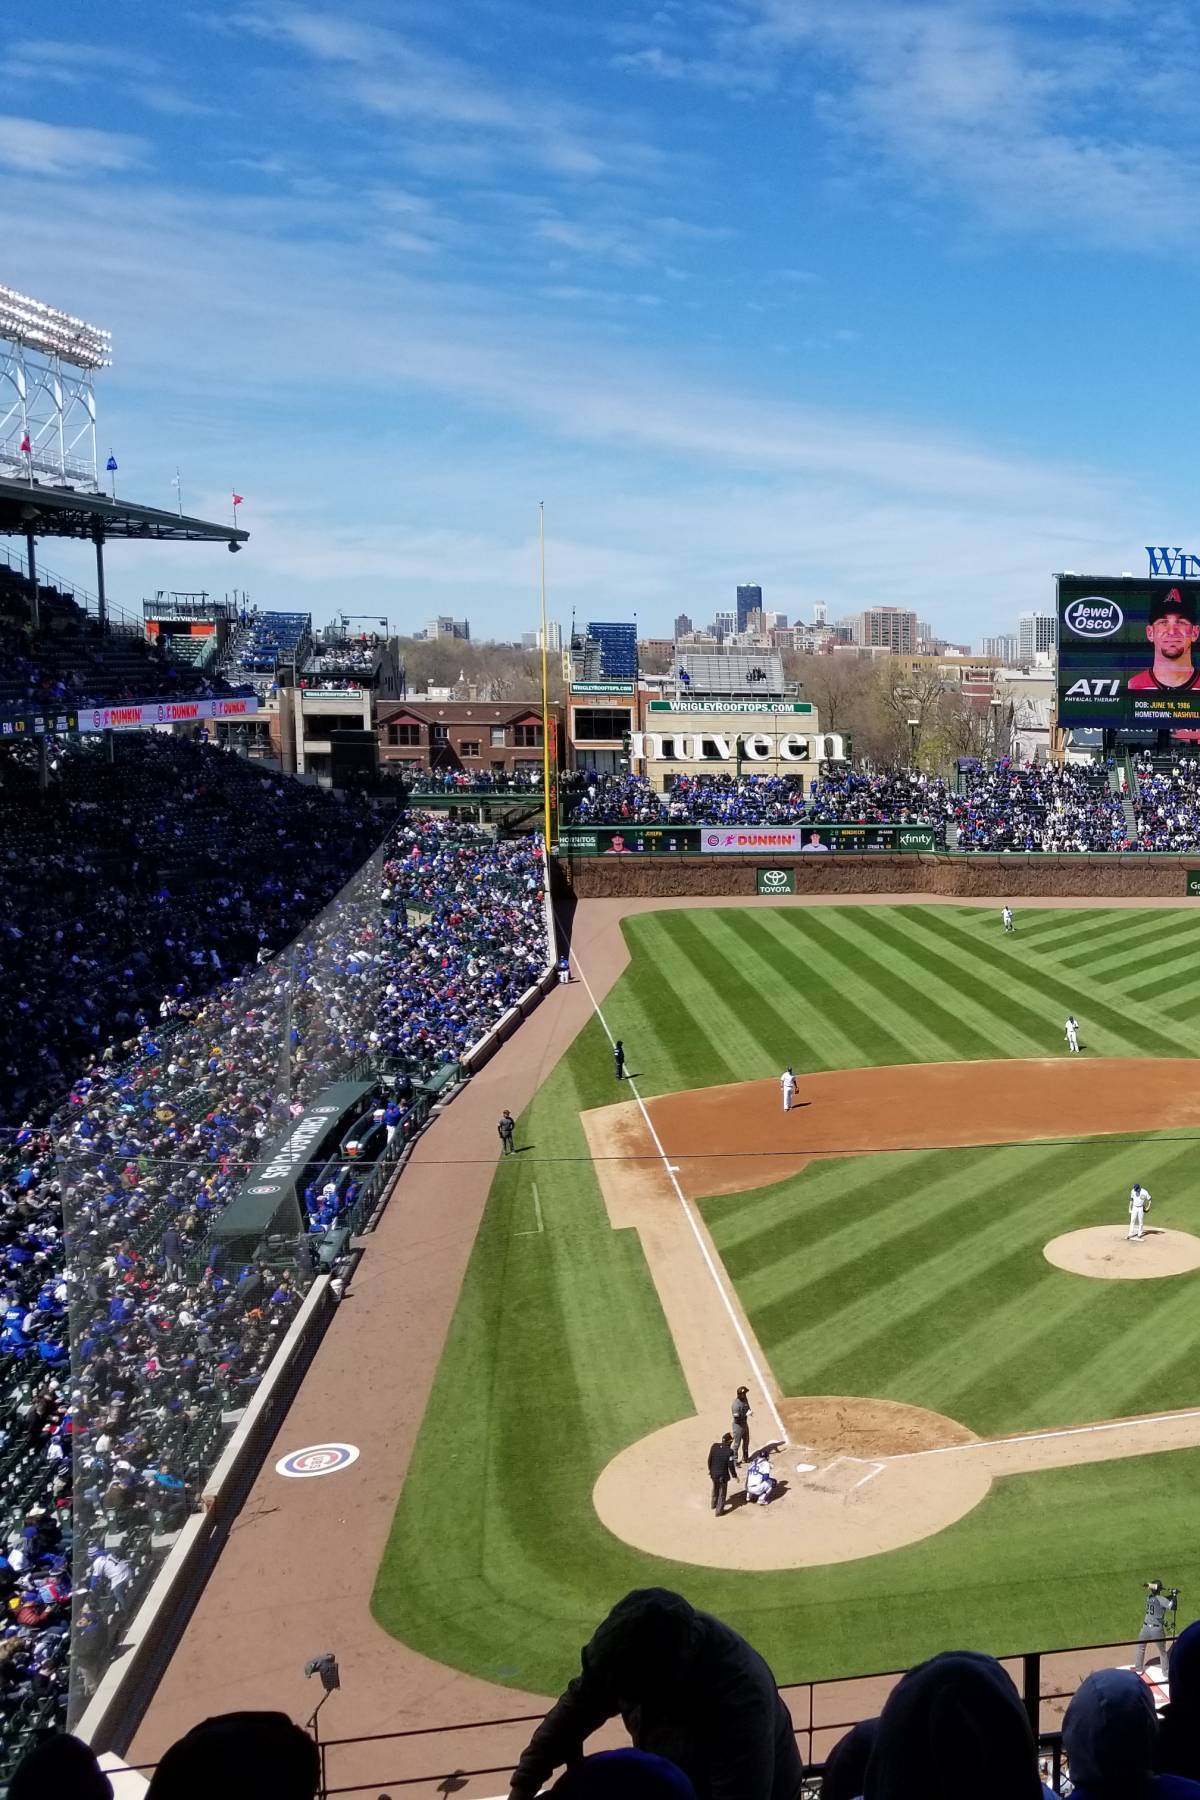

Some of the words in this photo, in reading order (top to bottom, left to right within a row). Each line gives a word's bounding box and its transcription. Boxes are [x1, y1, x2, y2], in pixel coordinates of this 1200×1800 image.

[1072, 604, 1113, 618] Jewel
[1075, 617, 1112, 629] Osco
[1066, 678, 1120, 696] ATI
[172, 704, 199, 719] DUNKIN'
[670, 701, 794, 713] WRIGLEYROOFTOPS.COM
[111, 709, 142, 725] DUNKIN'
[1135, 711, 1172, 719] HOMETOWN:
[628, 731, 847, 761] nuveen
[737, 835, 795, 846] DUNKIN'
[900, 832, 932, 846] xfinity
[760, 886, 791, 894] TOYOTA
[280, 1116, 328, 1152] CHICAGO
[259, 1153, 301, 1179] CUBS
